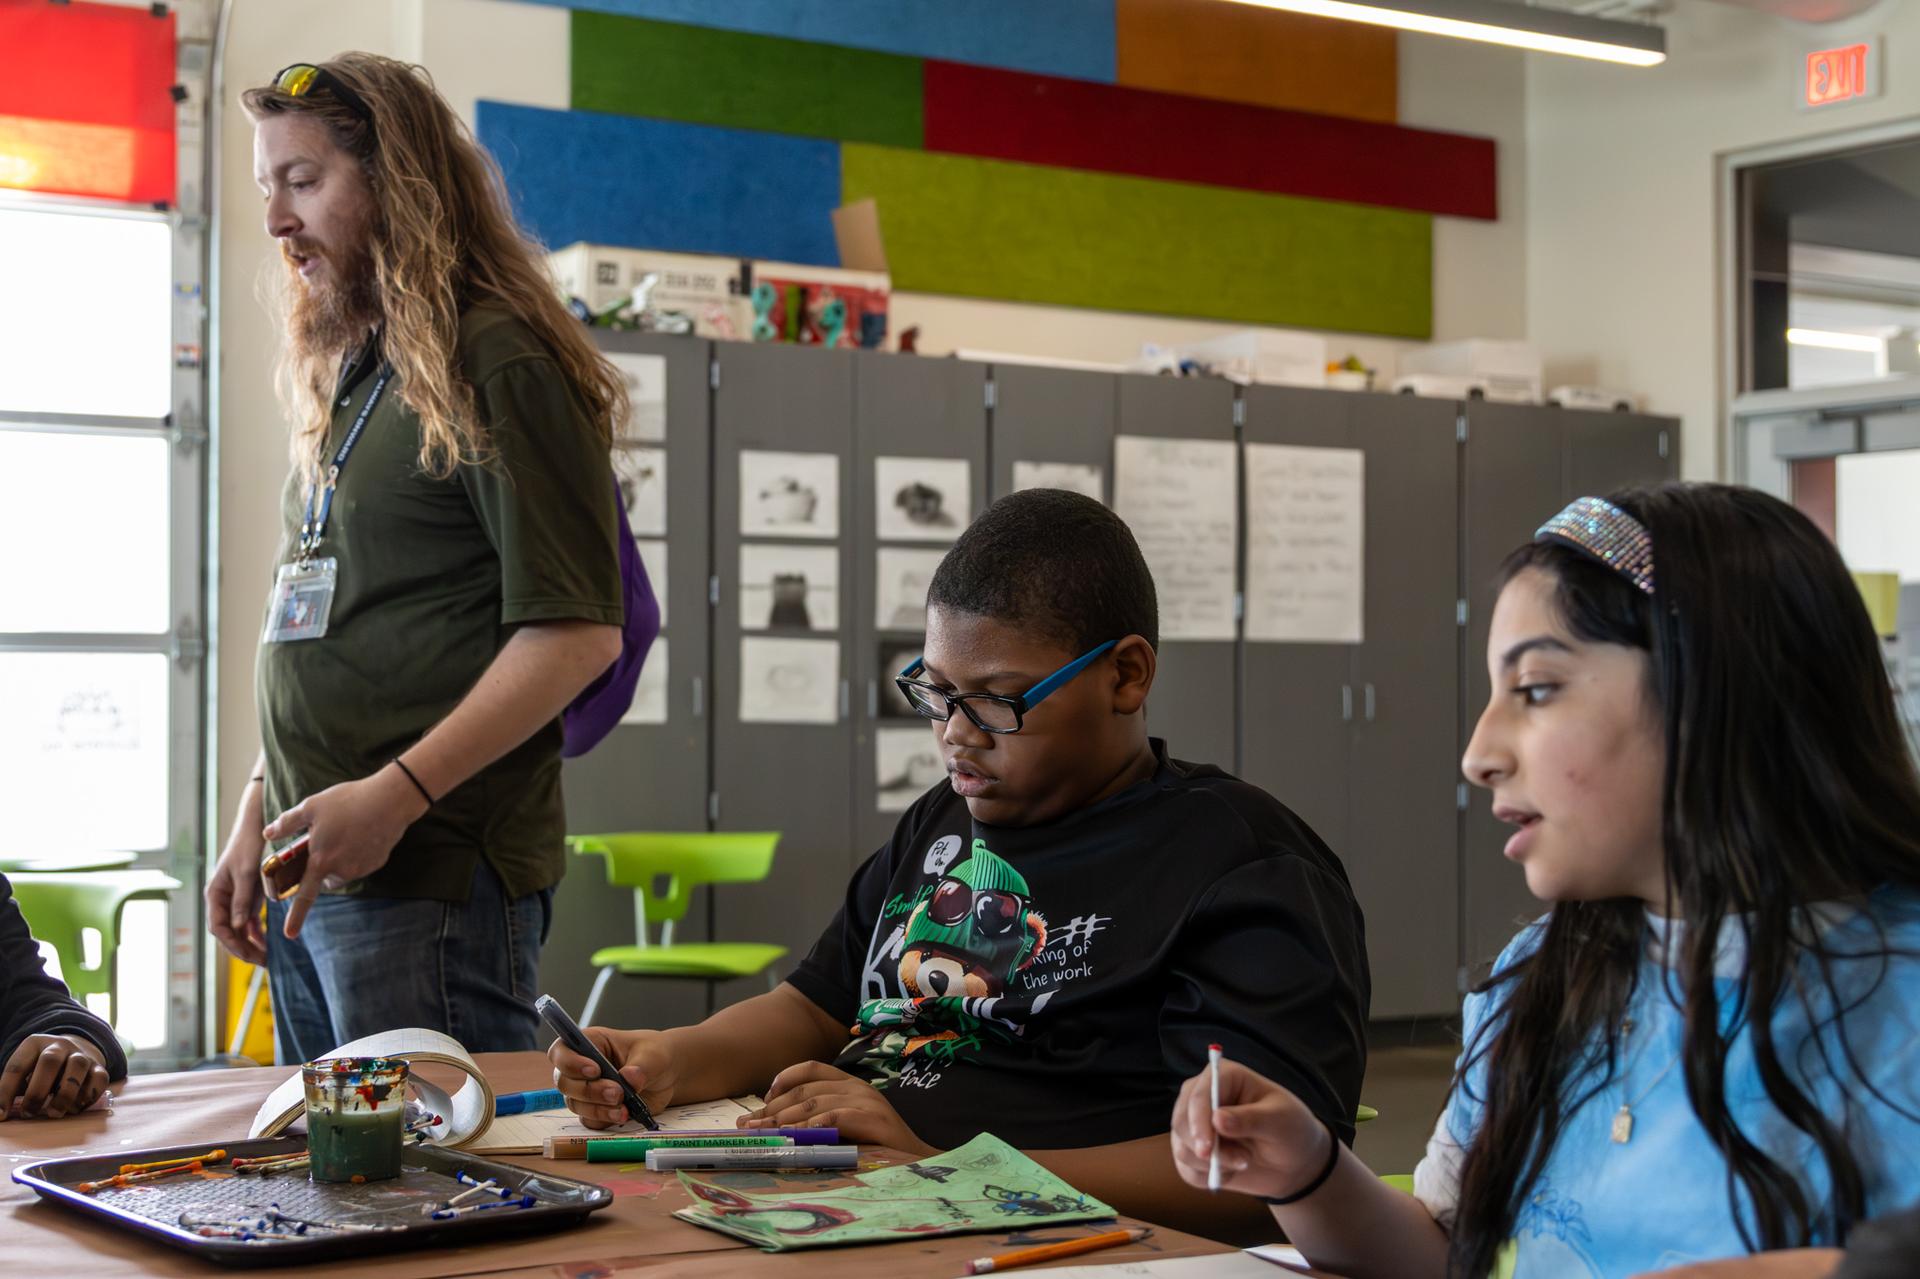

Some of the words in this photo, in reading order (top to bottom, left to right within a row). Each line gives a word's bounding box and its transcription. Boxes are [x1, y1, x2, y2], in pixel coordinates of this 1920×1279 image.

[1807, 43, 1868, 105] EXIT
[1073, 939, 1092, 957] of
[1022, 972, 1049, 990] the
[671, 1139, 701, 1147] PAINT
[703, 1138, 746, 1147] MARKER
[747, 1138, 767, 1146] PEN
